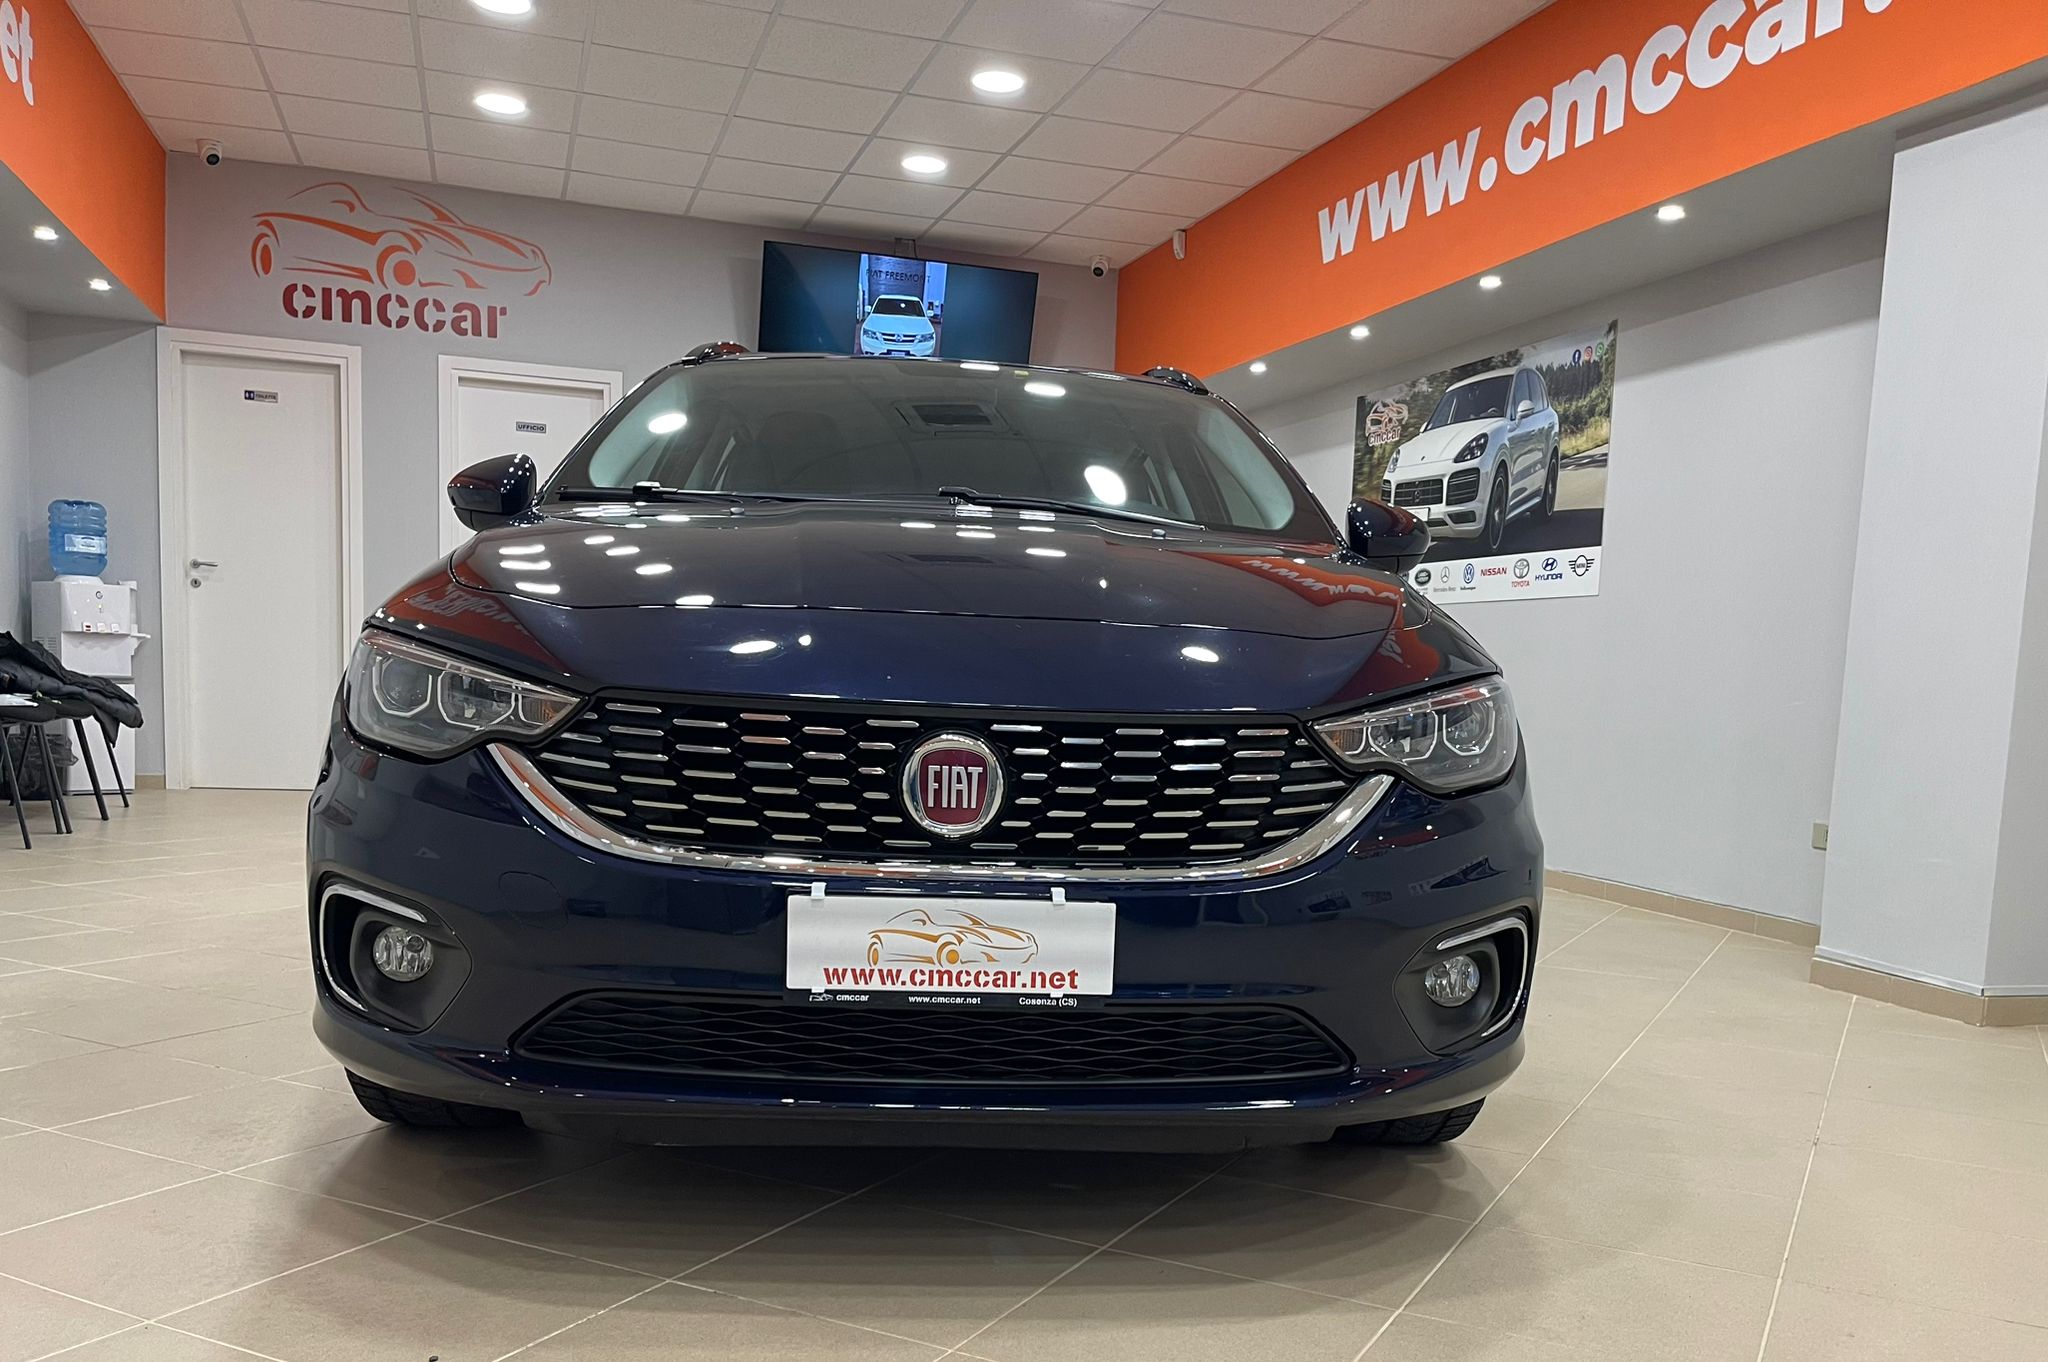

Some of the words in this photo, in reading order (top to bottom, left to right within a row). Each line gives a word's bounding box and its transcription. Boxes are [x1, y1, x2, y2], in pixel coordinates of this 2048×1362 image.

[282, 283, 508, 339] cmccar
[517, 424, 545, 432] UFFICIO
[1368, 427, 1401, 446] cmccar
[1480, 567, 1508, 577] NISSAN
[1534, 572, 1563, 581] HYUNDAI
[1511, 580, 1530, 588] TOYOTA
[927, 765, 983, 809] FIAT
[823, 967, 1079, 989] www.cmccar.net
[836, 994, 870, 1002] cmccar
[1058, 997, 1078, 1008] (CS)
